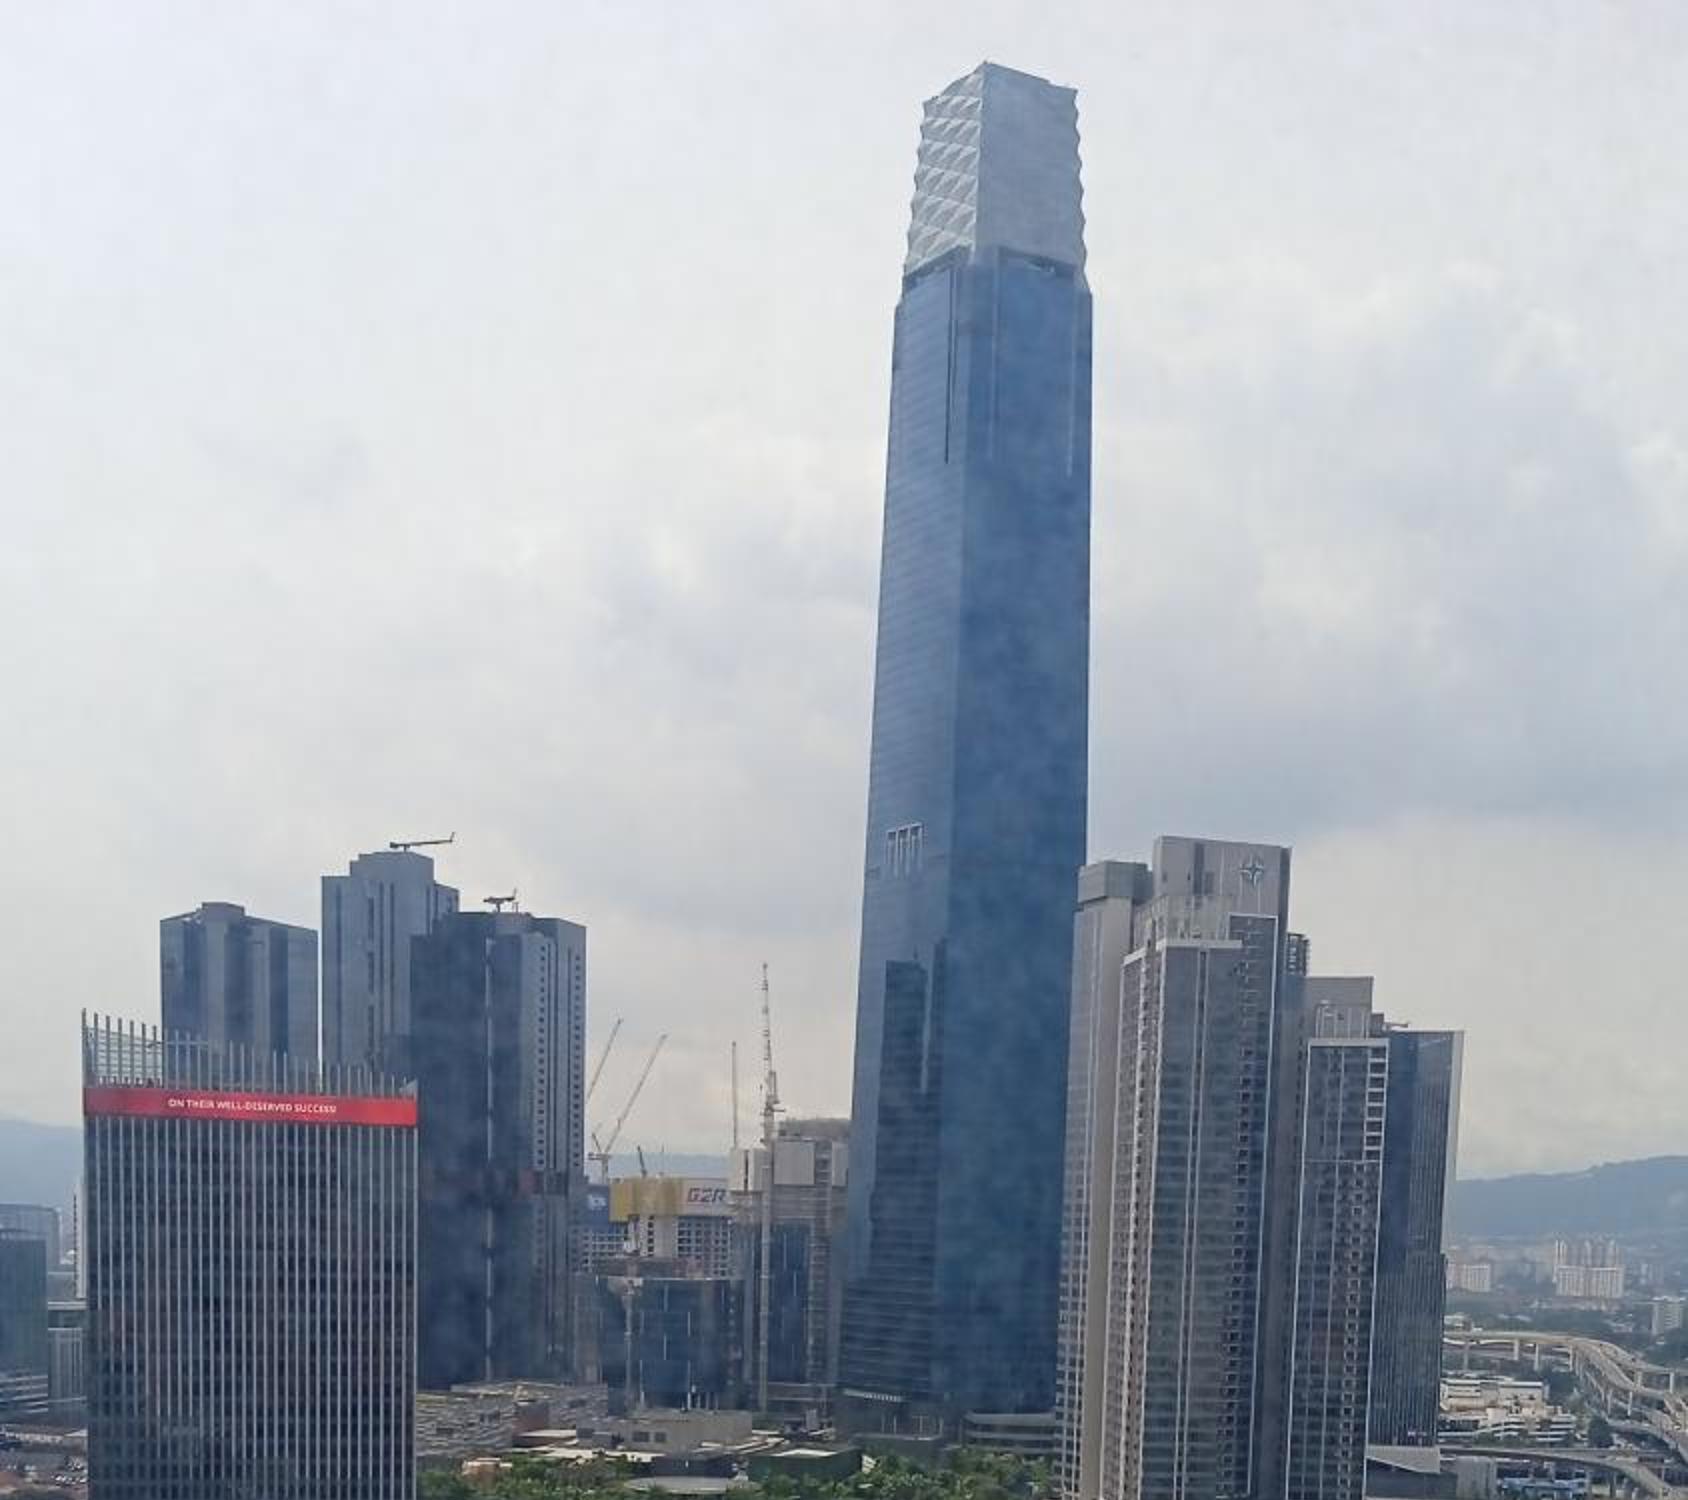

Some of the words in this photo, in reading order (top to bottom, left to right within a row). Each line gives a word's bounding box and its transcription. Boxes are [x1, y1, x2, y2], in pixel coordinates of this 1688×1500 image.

[168, 1099, 184, 1107] ON
[187, 1099, 214, 1109] THEIR
[216, 1101, 293, 1112] WELL-DESERVED
